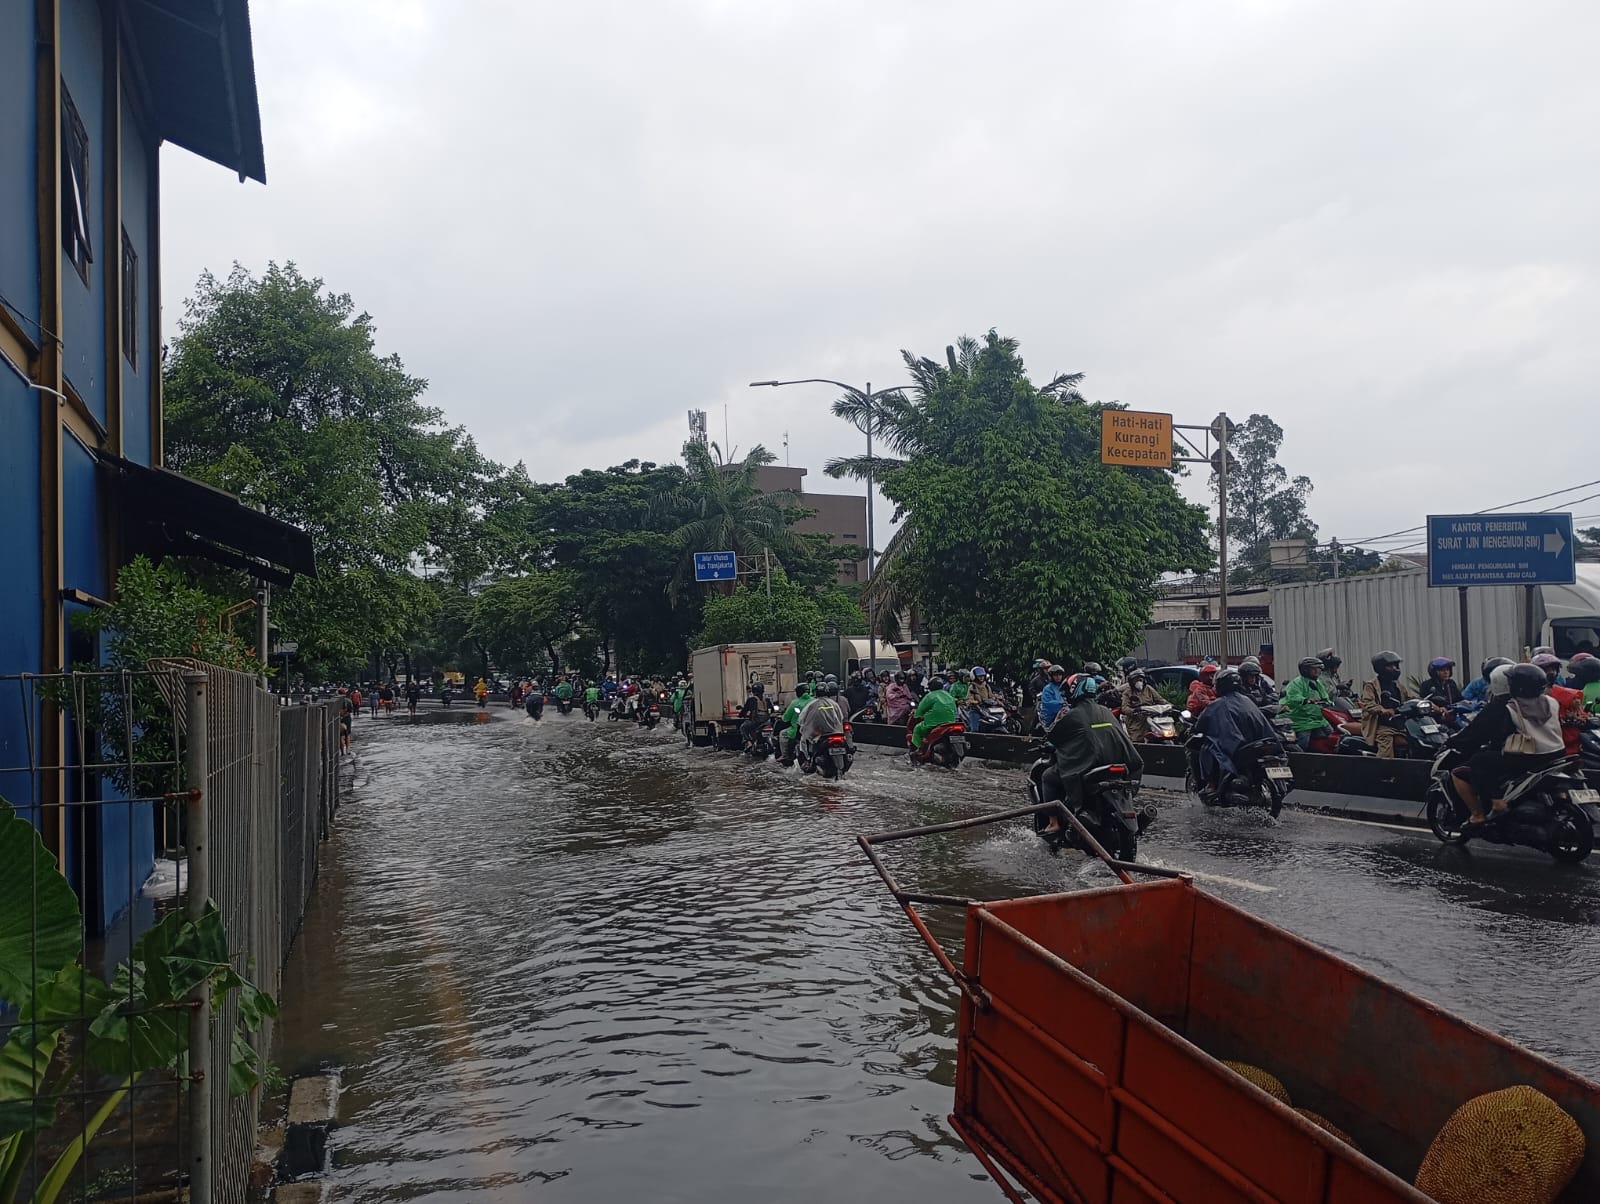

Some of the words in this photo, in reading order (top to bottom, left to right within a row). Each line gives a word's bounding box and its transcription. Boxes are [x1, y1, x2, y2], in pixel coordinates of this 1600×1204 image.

[1112, 416, 1162, 430] Hati-Hati
[1115, 431, 1159, 447] Kurangi
[1107, 446, 1166, 461] Kecepatan
[1452, 523, 1482, 532] KANTOR
[1485, 521, 1527, 532] PENERBITAN
[1438, 537, 1463, 550] SURAT
